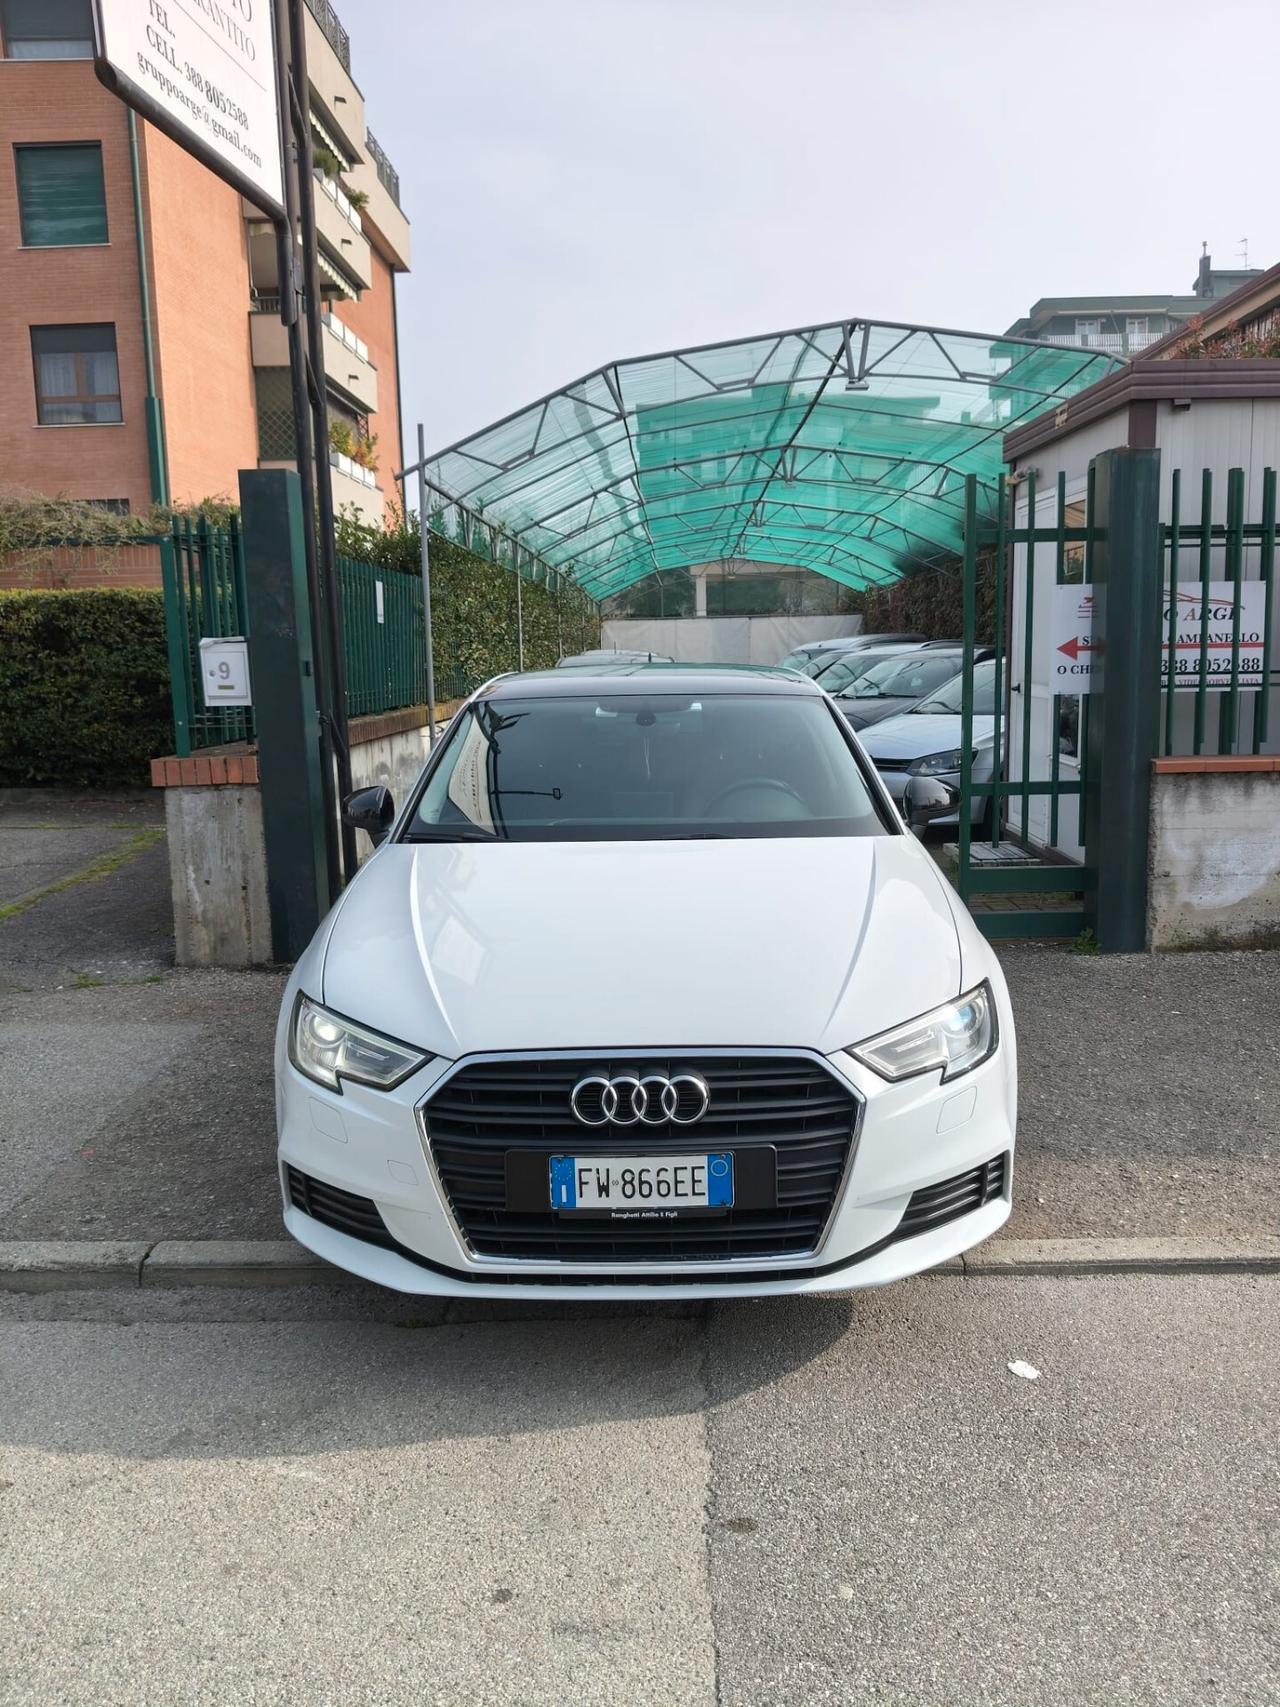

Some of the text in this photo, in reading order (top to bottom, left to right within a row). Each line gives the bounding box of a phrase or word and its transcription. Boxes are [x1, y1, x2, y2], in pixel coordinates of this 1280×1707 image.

[149, 0, 176, 39] TEL.
[146, 24, 183, 74] CELL.
[136, 51, 263, 169] gruppoarge@gmail.com
[217, 661, 231, 680] 9
